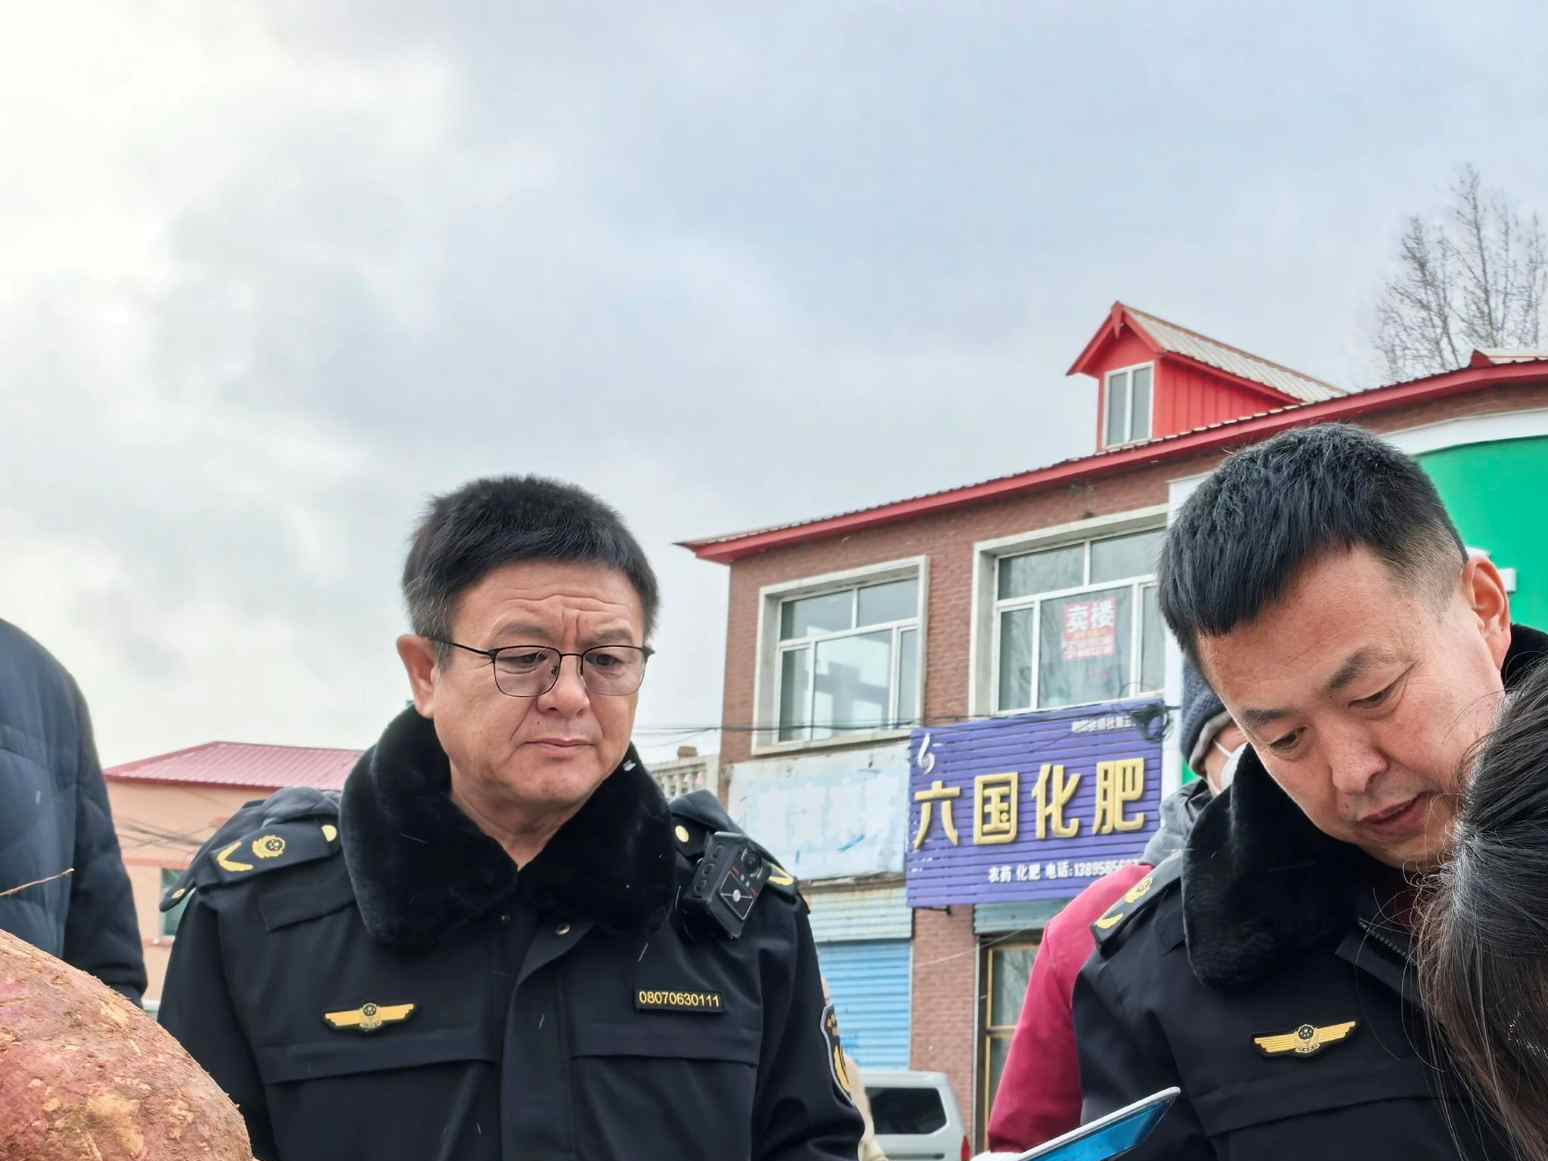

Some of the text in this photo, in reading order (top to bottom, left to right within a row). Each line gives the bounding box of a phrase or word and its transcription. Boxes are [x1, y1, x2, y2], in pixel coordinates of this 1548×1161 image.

[914, 757, 1145, 849] 六国化肥
[639, 991, 720, 1007] 08070630111
